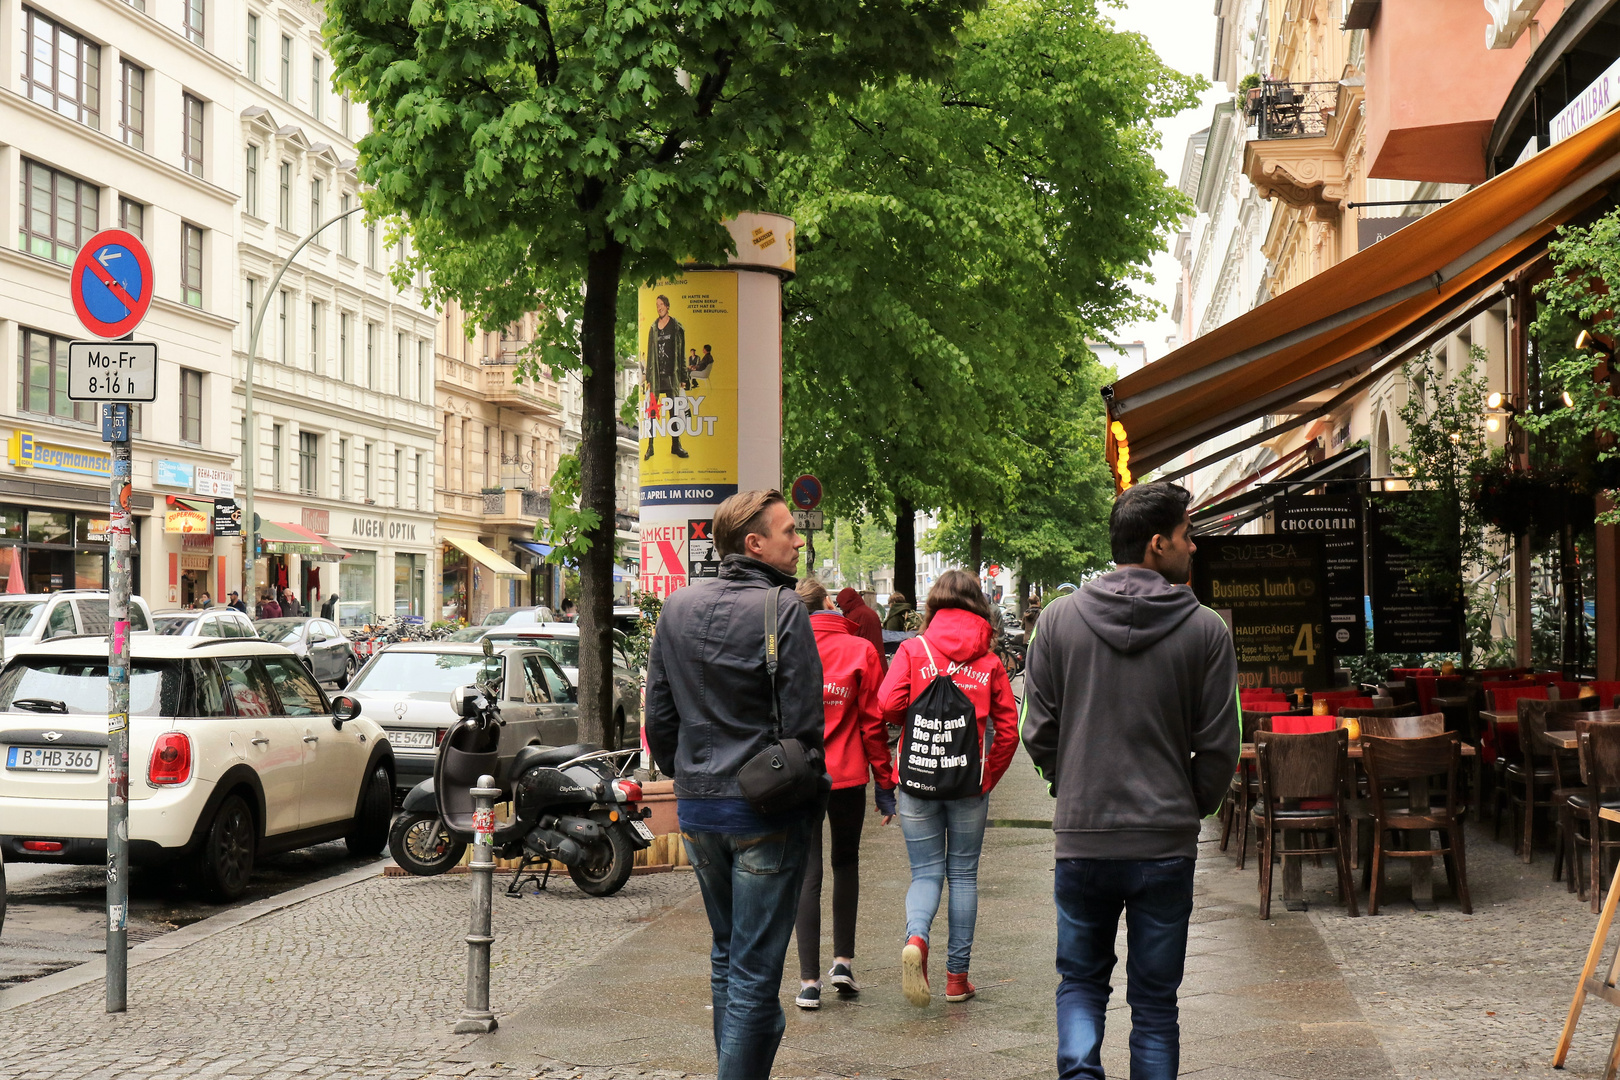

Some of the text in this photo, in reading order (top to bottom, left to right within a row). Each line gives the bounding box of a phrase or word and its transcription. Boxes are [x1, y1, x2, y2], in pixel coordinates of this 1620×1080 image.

[1556, 76, 1610, 142] COCKTAILBAR
[88, 351, 136, 369] Mo-Fr
[88, 376, 135, 394] 8-16 h
[639, 392, 706, 419] HAPPY
[647, 490, 668, 500] APRIL
[669, 489, 682, 499] IM
[685, 488, 714, 499] KINO
[352, 517, 385, 539] AUGEN
[389, 521, 416, 540] OPTIK
[690, 522, 708, 539] X
[1221, 543, 1297, 561] SWERA
[1212, 576, 1296, 598] Business Lunch
[1235, 624, 1295, 636] HAUPTGÄNGE
[1241, 645, 1257, 654] Suppe
[1292, 623, 1323, 665] 4 €
[1277, 653, 1290, 661] Salat
[946, 660, 990, 686] Artistik
[1268, 666, 1304, 685] Hour
[944, 715, 966, 730] and
[404, 733, 432, 744] 5477
[912, 727, 930, 742] the
[910, 741, 929, 754] are
[22, 750, 93, 767] B HB 366
[908, 754, 968, 769] same thing
[921, 783, 936, 792] Berlin
